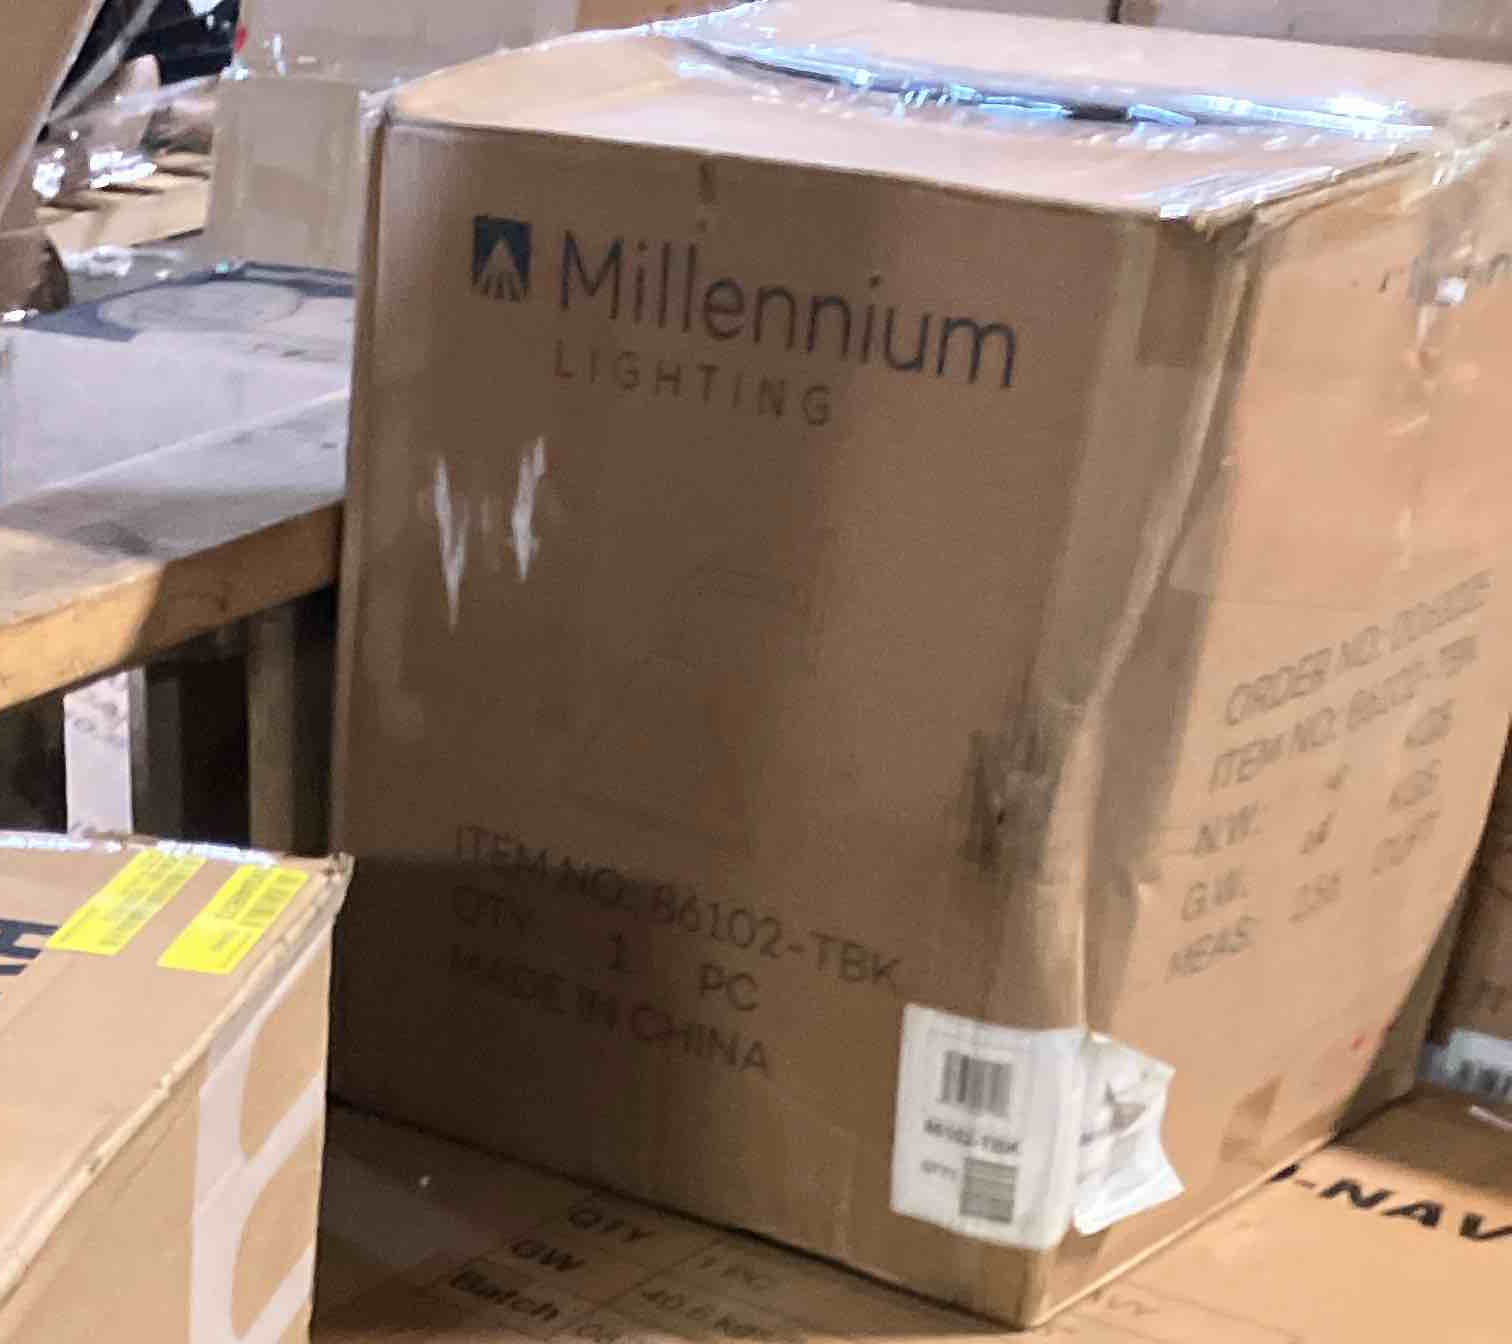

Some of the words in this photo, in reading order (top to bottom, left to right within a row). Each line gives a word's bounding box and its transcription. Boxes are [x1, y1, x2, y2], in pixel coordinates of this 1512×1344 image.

[560, 225, 1018, 390] Millennium
[554, 344, 834, 428] LIGHTING
[456, 824, 548, 882] ITEM
[700, 963, 760, 1011] PC
[632, 1004, 771, 1078] CHINA
